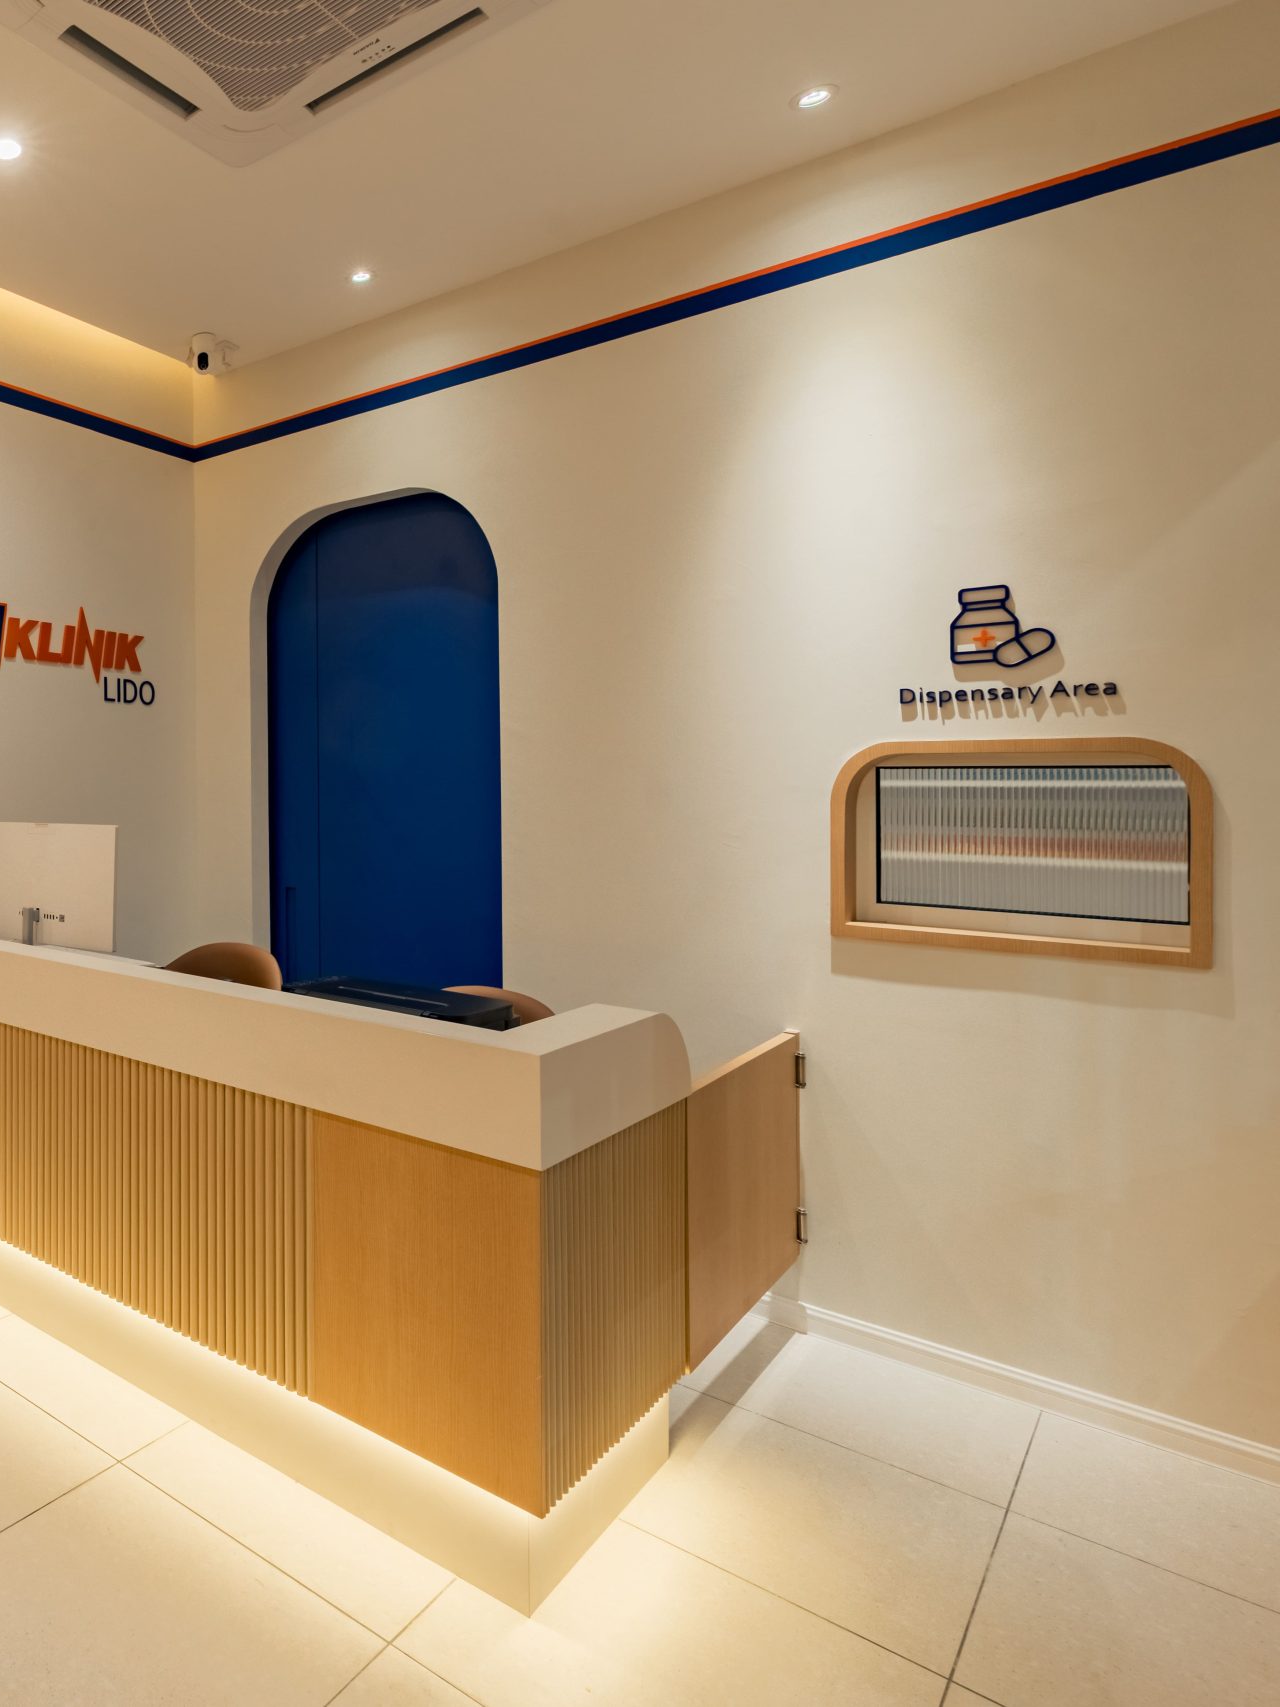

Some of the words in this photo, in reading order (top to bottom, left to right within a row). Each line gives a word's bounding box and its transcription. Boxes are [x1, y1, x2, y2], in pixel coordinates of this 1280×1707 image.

[4, 606, 144, 684] KLINIK
[104, 677, 155, 705] LIDO
[899, 686, 1042, 708] Dispensary
[1050, 680, 1118, 698] Area
